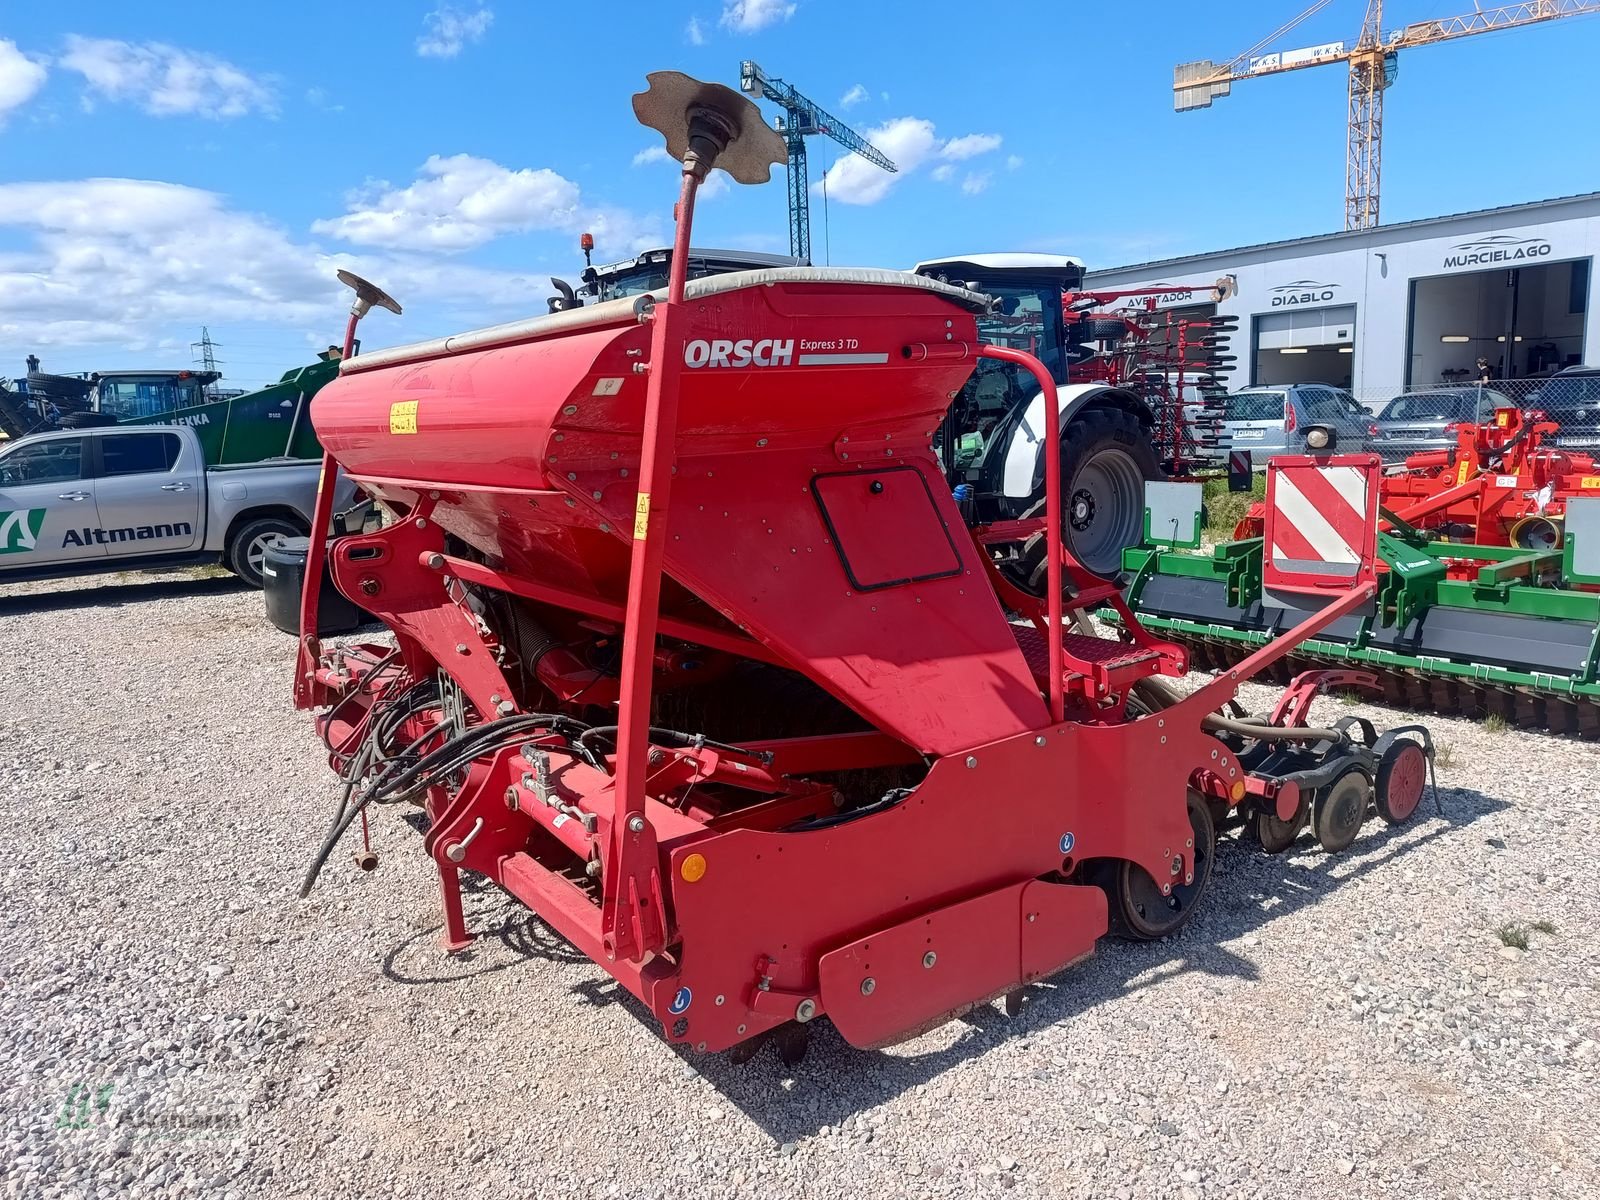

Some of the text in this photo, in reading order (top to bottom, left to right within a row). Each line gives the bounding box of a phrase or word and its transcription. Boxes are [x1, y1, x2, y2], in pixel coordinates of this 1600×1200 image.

[1443, 244, 1552, 269] MURCIELAGO
[1127, 291, 1193, 308] AVETADOR
[1271, 291, 1334, 307] DIABLO
[682, 339, 795, 369] ORSCH
[800, 338, 859, 351] Express 3 TD
[61, 521, 192, 548] Altmann
